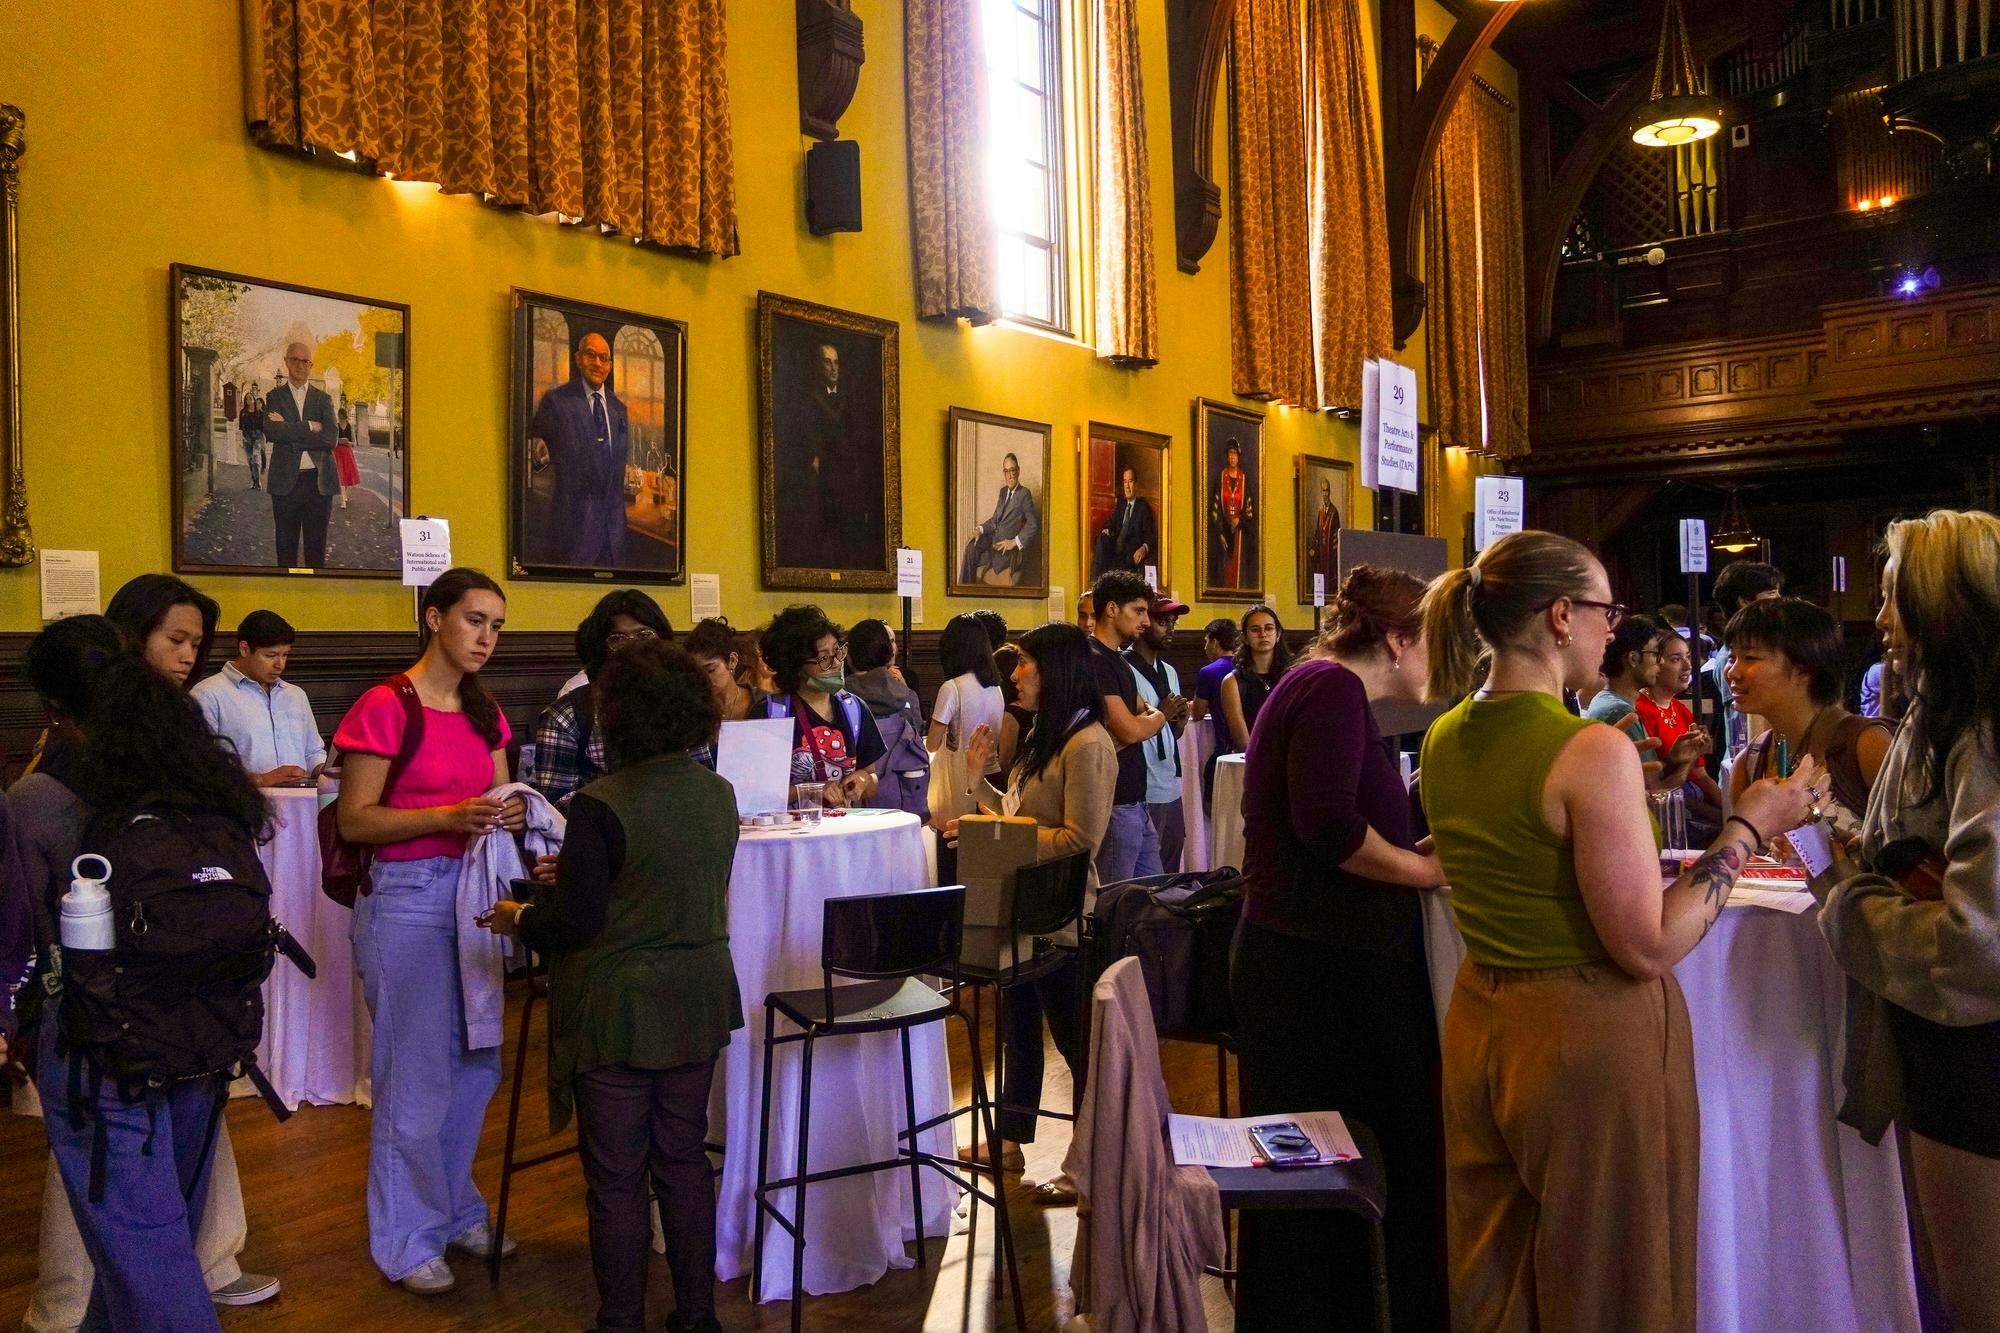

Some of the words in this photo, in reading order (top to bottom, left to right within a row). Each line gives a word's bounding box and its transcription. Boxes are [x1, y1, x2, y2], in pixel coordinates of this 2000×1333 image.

[1393, 385, 1404, 405] 29
[1382, 422, 1400, 436] Theatre
[1401, 428, 1410, 439] Arts
[1384, 440, 1413, 455] Performance
[1381, 456, 1399, 468] Studies
[1498, 490, 1510, 503] 23
[419, 531, 431, 541] 31
